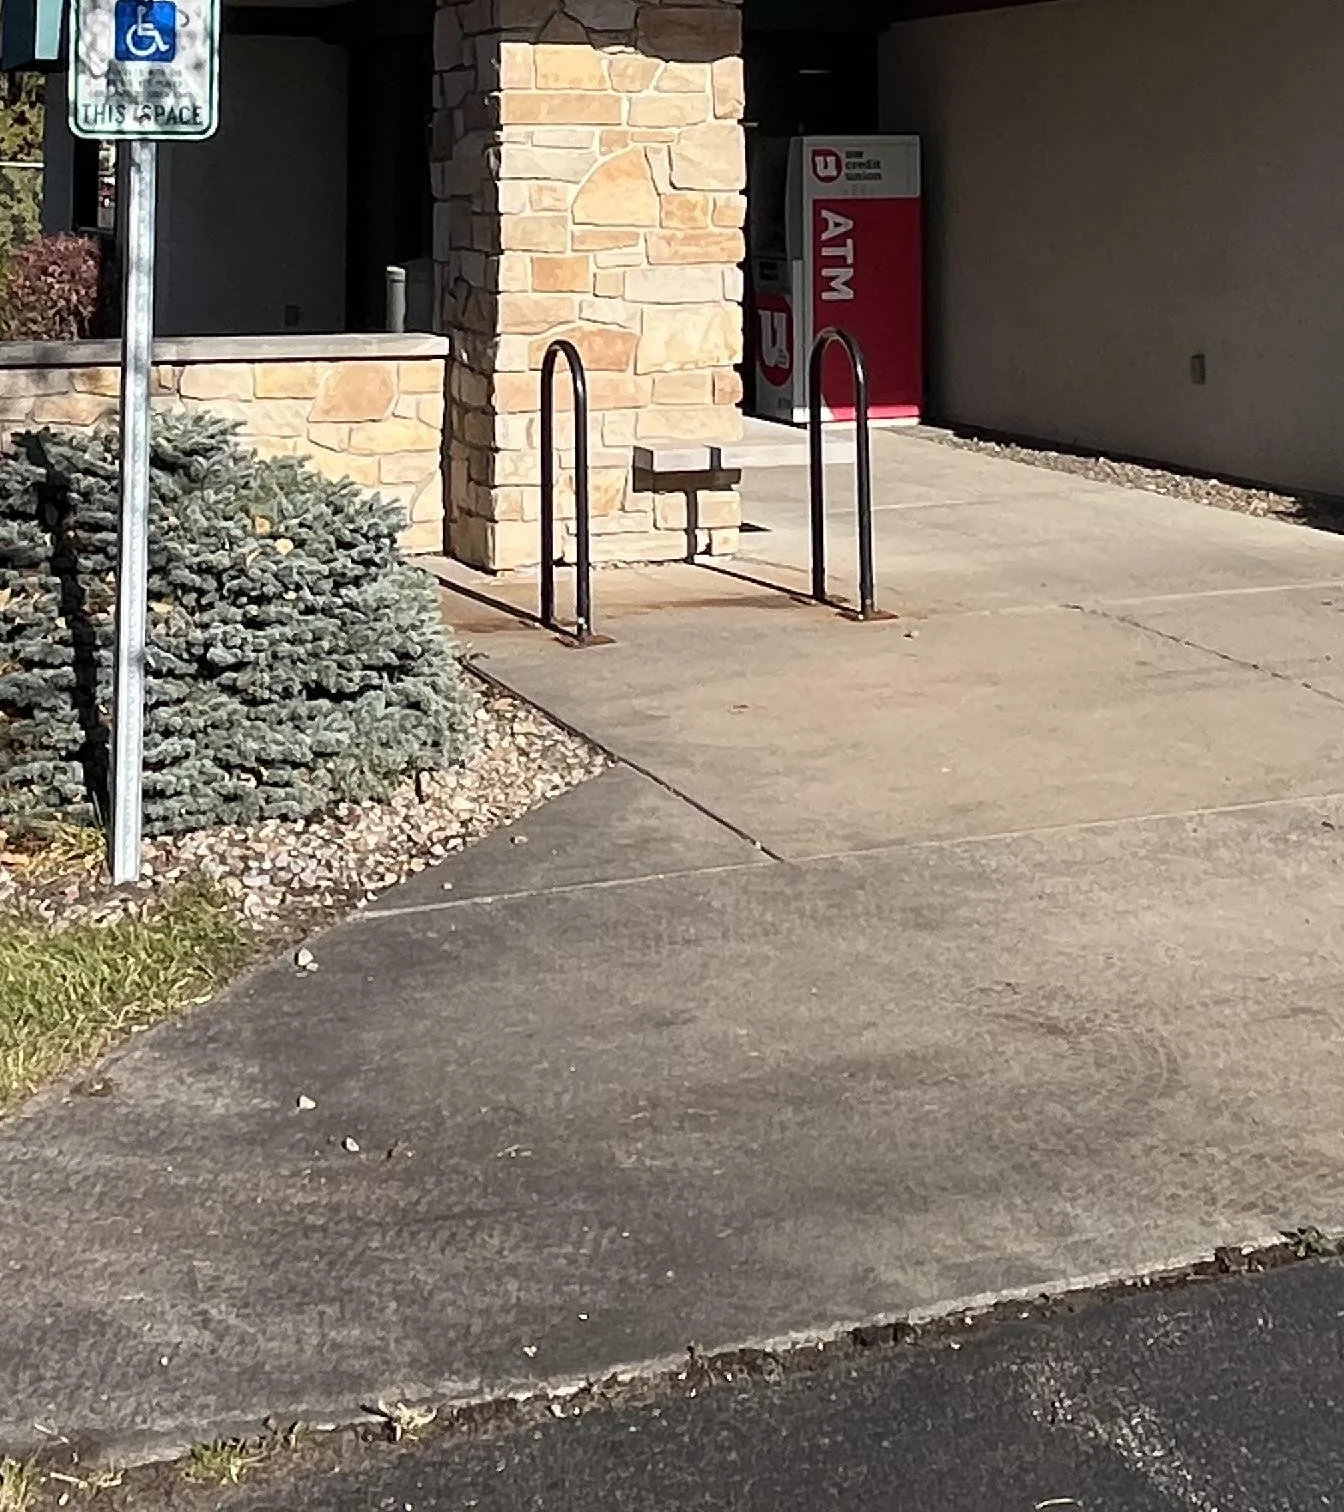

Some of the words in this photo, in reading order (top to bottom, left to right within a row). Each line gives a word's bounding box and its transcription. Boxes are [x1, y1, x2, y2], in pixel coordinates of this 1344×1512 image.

[82, 104, 126, 125] THIS
[140, 104, 204, 126] SPACE
[820, 209, 854, 301] ATM
